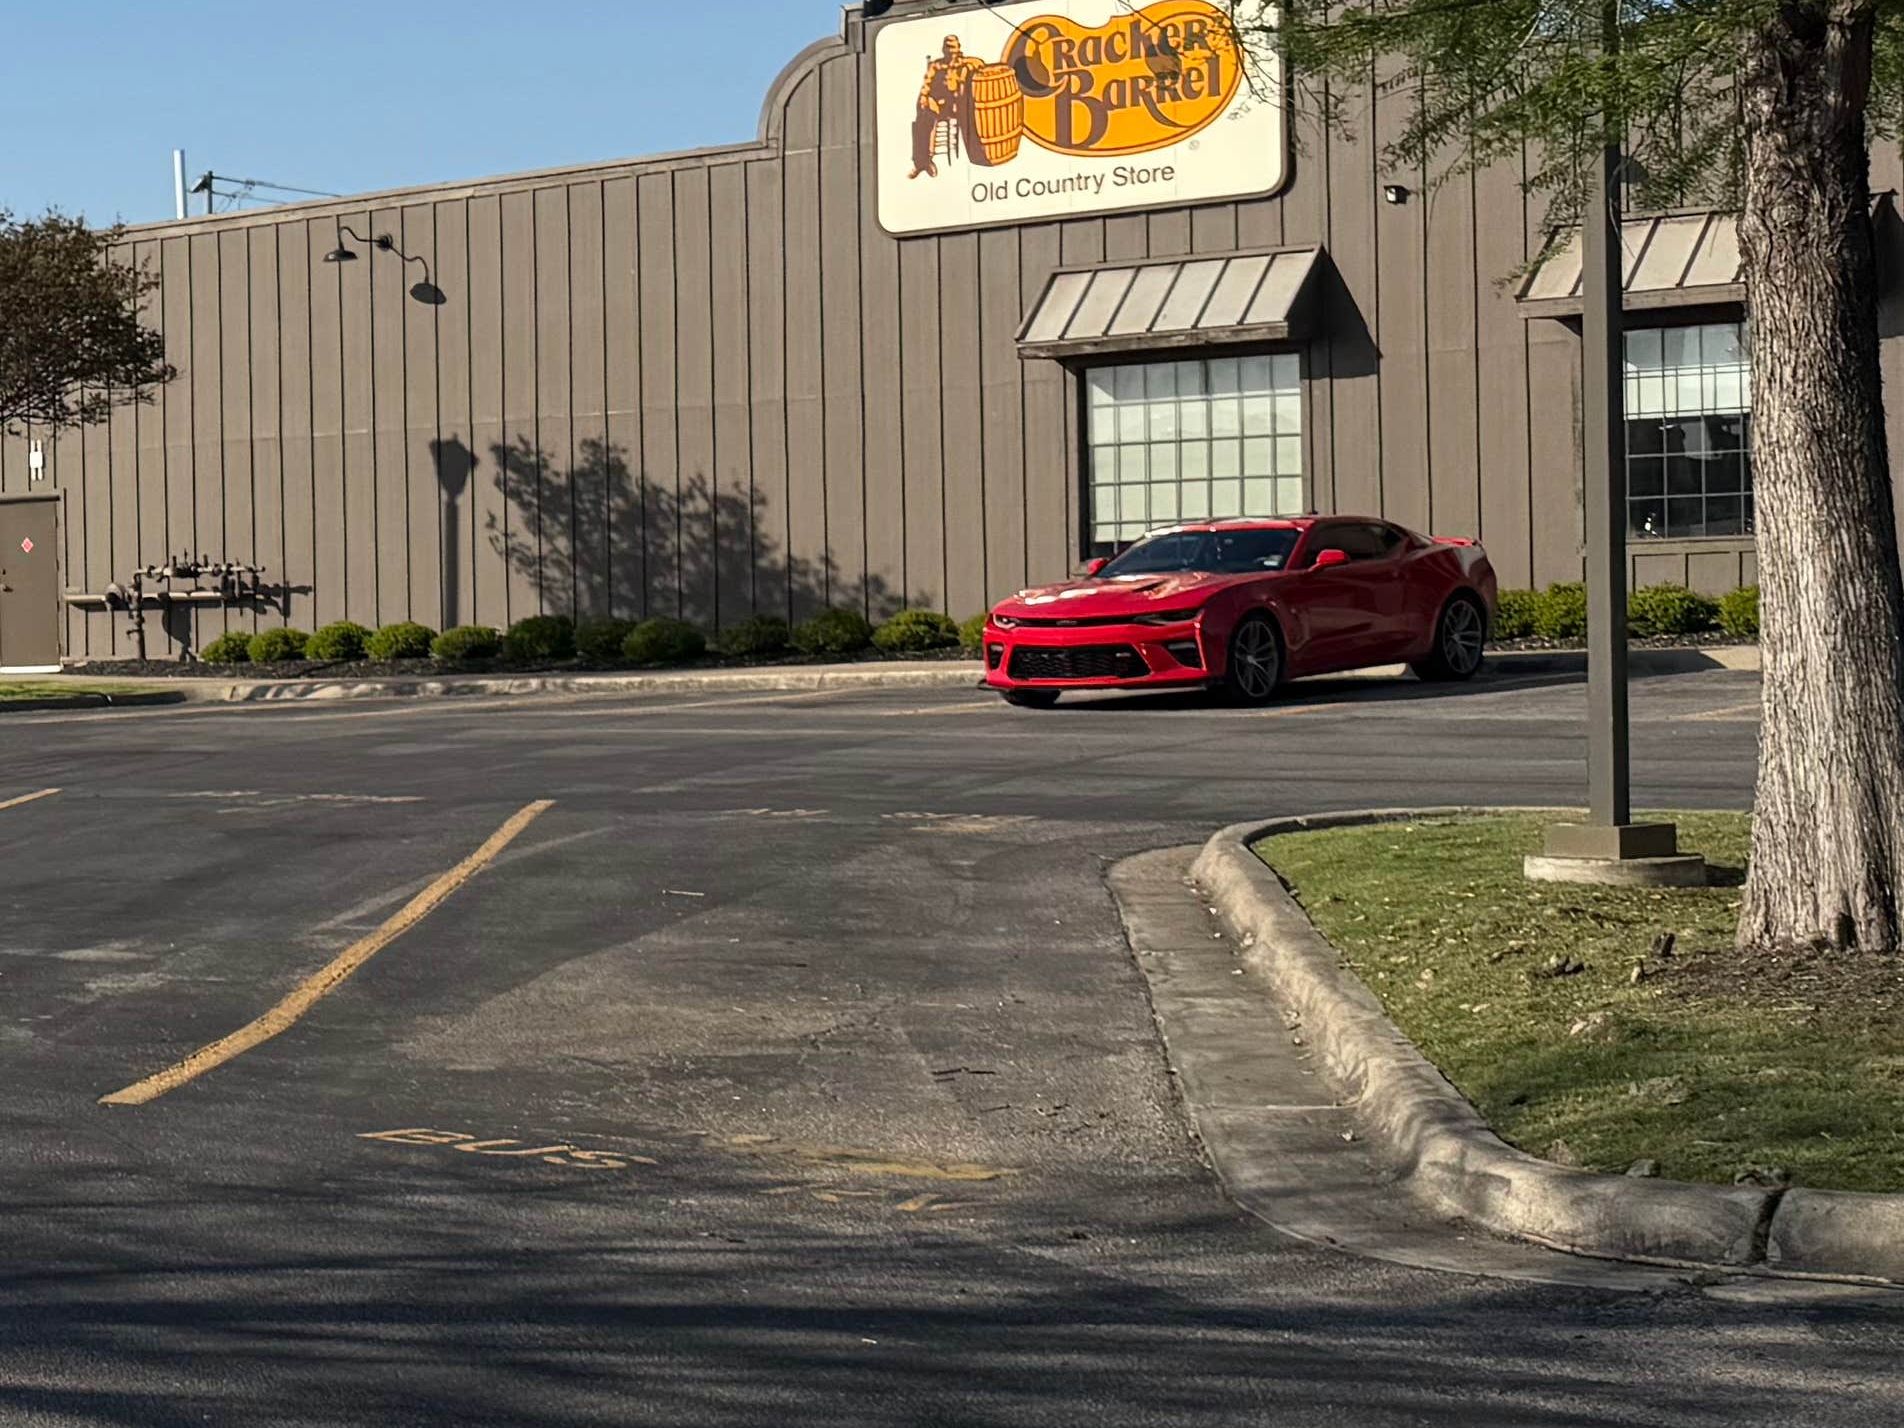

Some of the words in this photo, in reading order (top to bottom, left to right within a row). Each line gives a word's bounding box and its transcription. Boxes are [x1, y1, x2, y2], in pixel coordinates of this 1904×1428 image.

[1008, 19, 1210, 97] Cracker
[1052, 56, 1221, 149] Barrel
[971, 180, 1008, 203] Old
[1016, 173, 1106, 198] Country
[1113, 165, 1175, 187] Store
[354, 1128, 660, 1169] BUS
